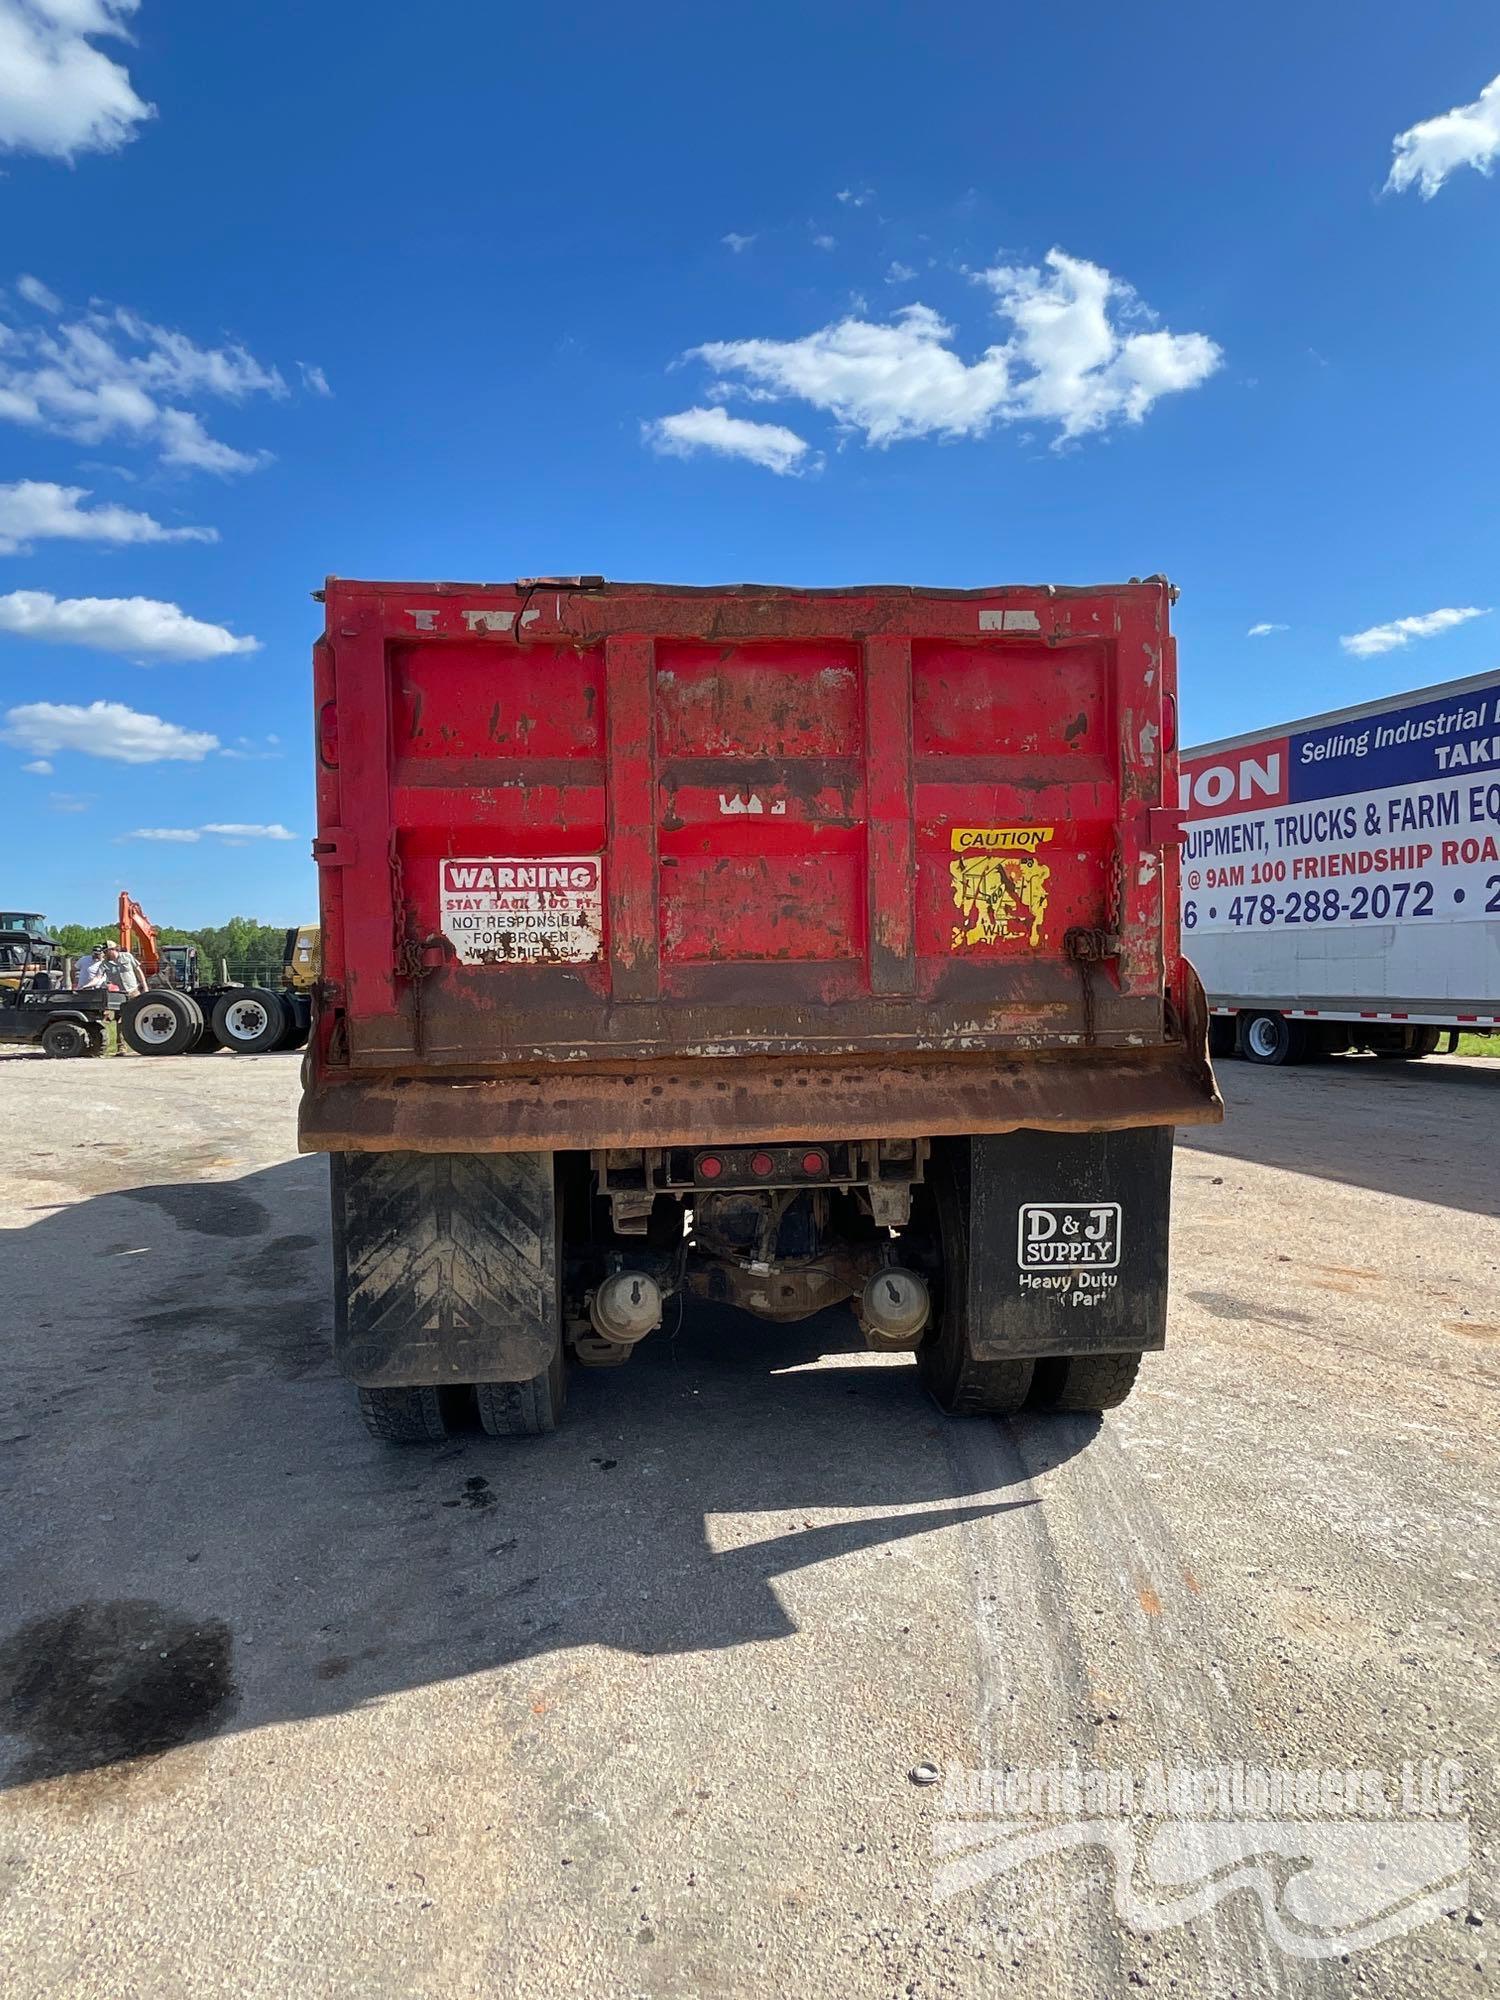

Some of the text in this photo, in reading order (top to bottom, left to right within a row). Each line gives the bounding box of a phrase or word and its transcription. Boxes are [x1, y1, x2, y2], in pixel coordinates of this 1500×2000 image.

[1300, 732, 1369, 765] Selling
[1374, 702, 1487, 749] Industrial
[1274, 805, 1357, 848] TRUCKS
[1364, 802, 1381, 837] &
[1388, 790, 1459, 833] FARM
[960, 832, 1045, 846] CAUTION
[1187, 870, 1201, 891] @
[1206, 865, 1244, 889] 9AM
[1251, 860, 1286, 884] 100
[1292, 843, 1433, 880] FRIENDSHIP
[449, 867, 591, 889] WARNING
[446, 899, 482, 911] STAY
[1228, 880, 1434, 926] 478-288-2072
[452, 916, 481, 929] NOT
[1027, 1242, 1112, 1262] SUPPLY
[1019, 1274, 1072, 1292] Heavy
